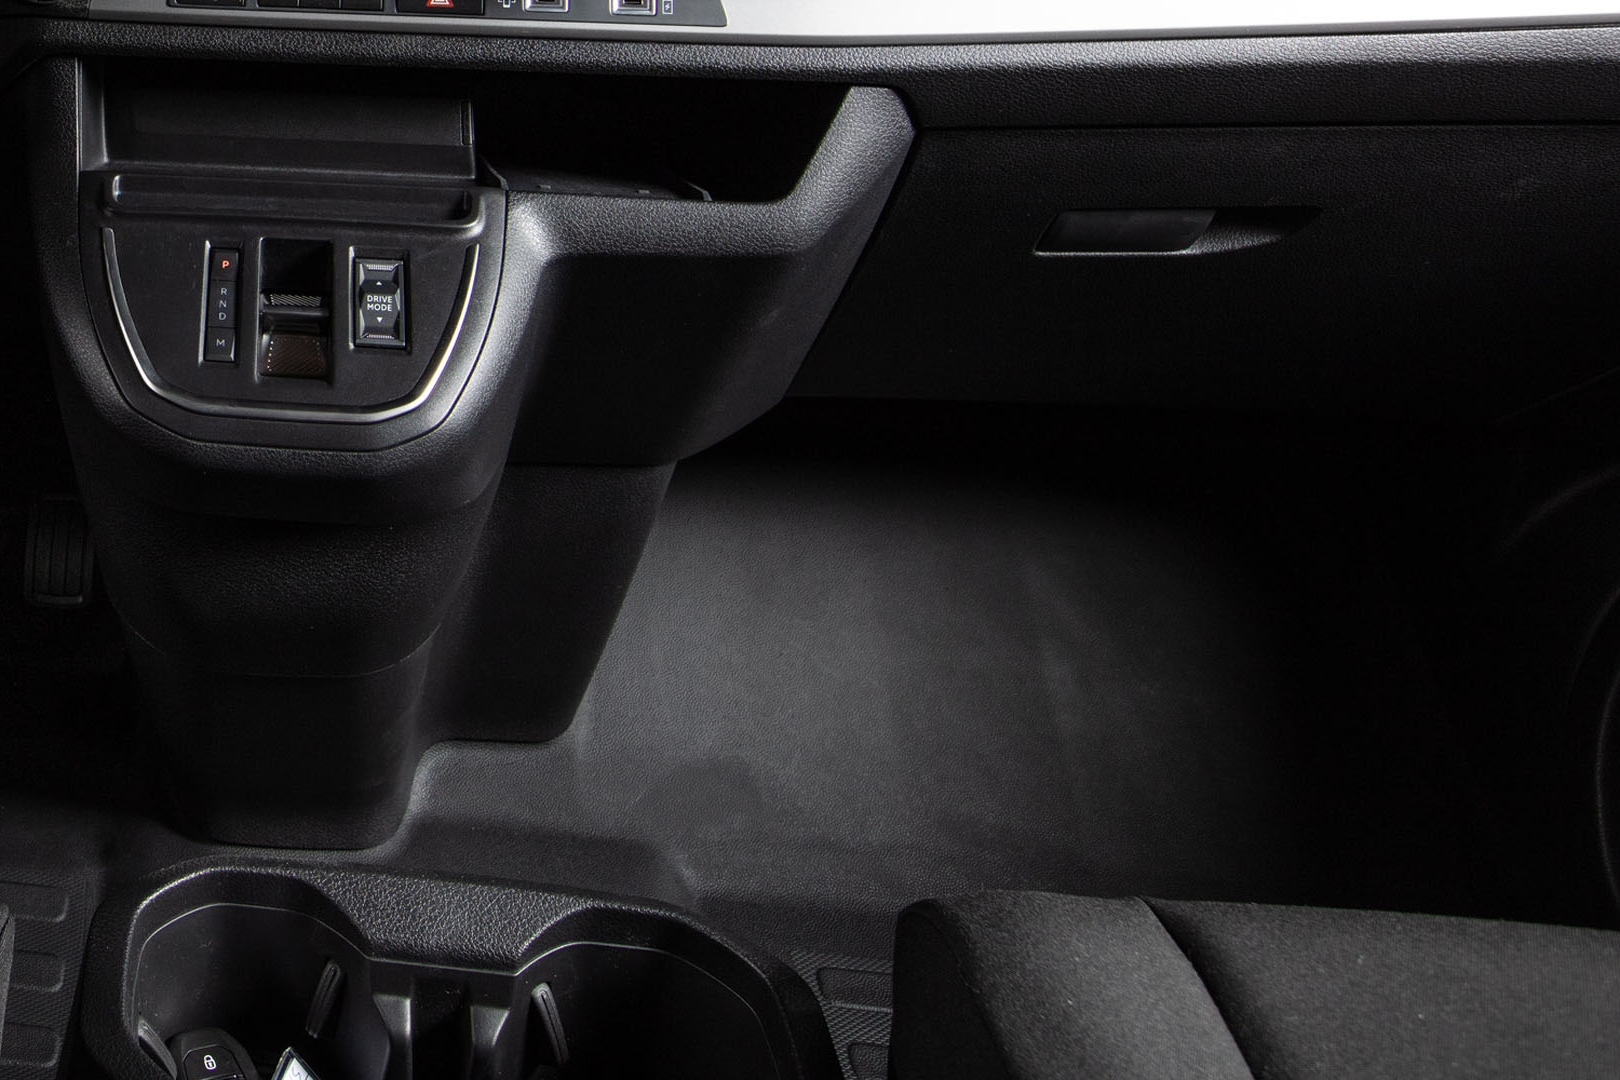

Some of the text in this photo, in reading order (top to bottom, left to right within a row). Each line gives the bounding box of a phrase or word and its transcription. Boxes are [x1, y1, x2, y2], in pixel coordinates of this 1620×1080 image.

[222, 260, 230, 269] P
[220, 287, 228, 296] R
[219, 300, 227, 308] N
[367, 295, 393, 304] DRIVE
[367, 303, 393, 312] MODE
[218, 312, 227, 321] D
[216, 338, 226, 347] M
